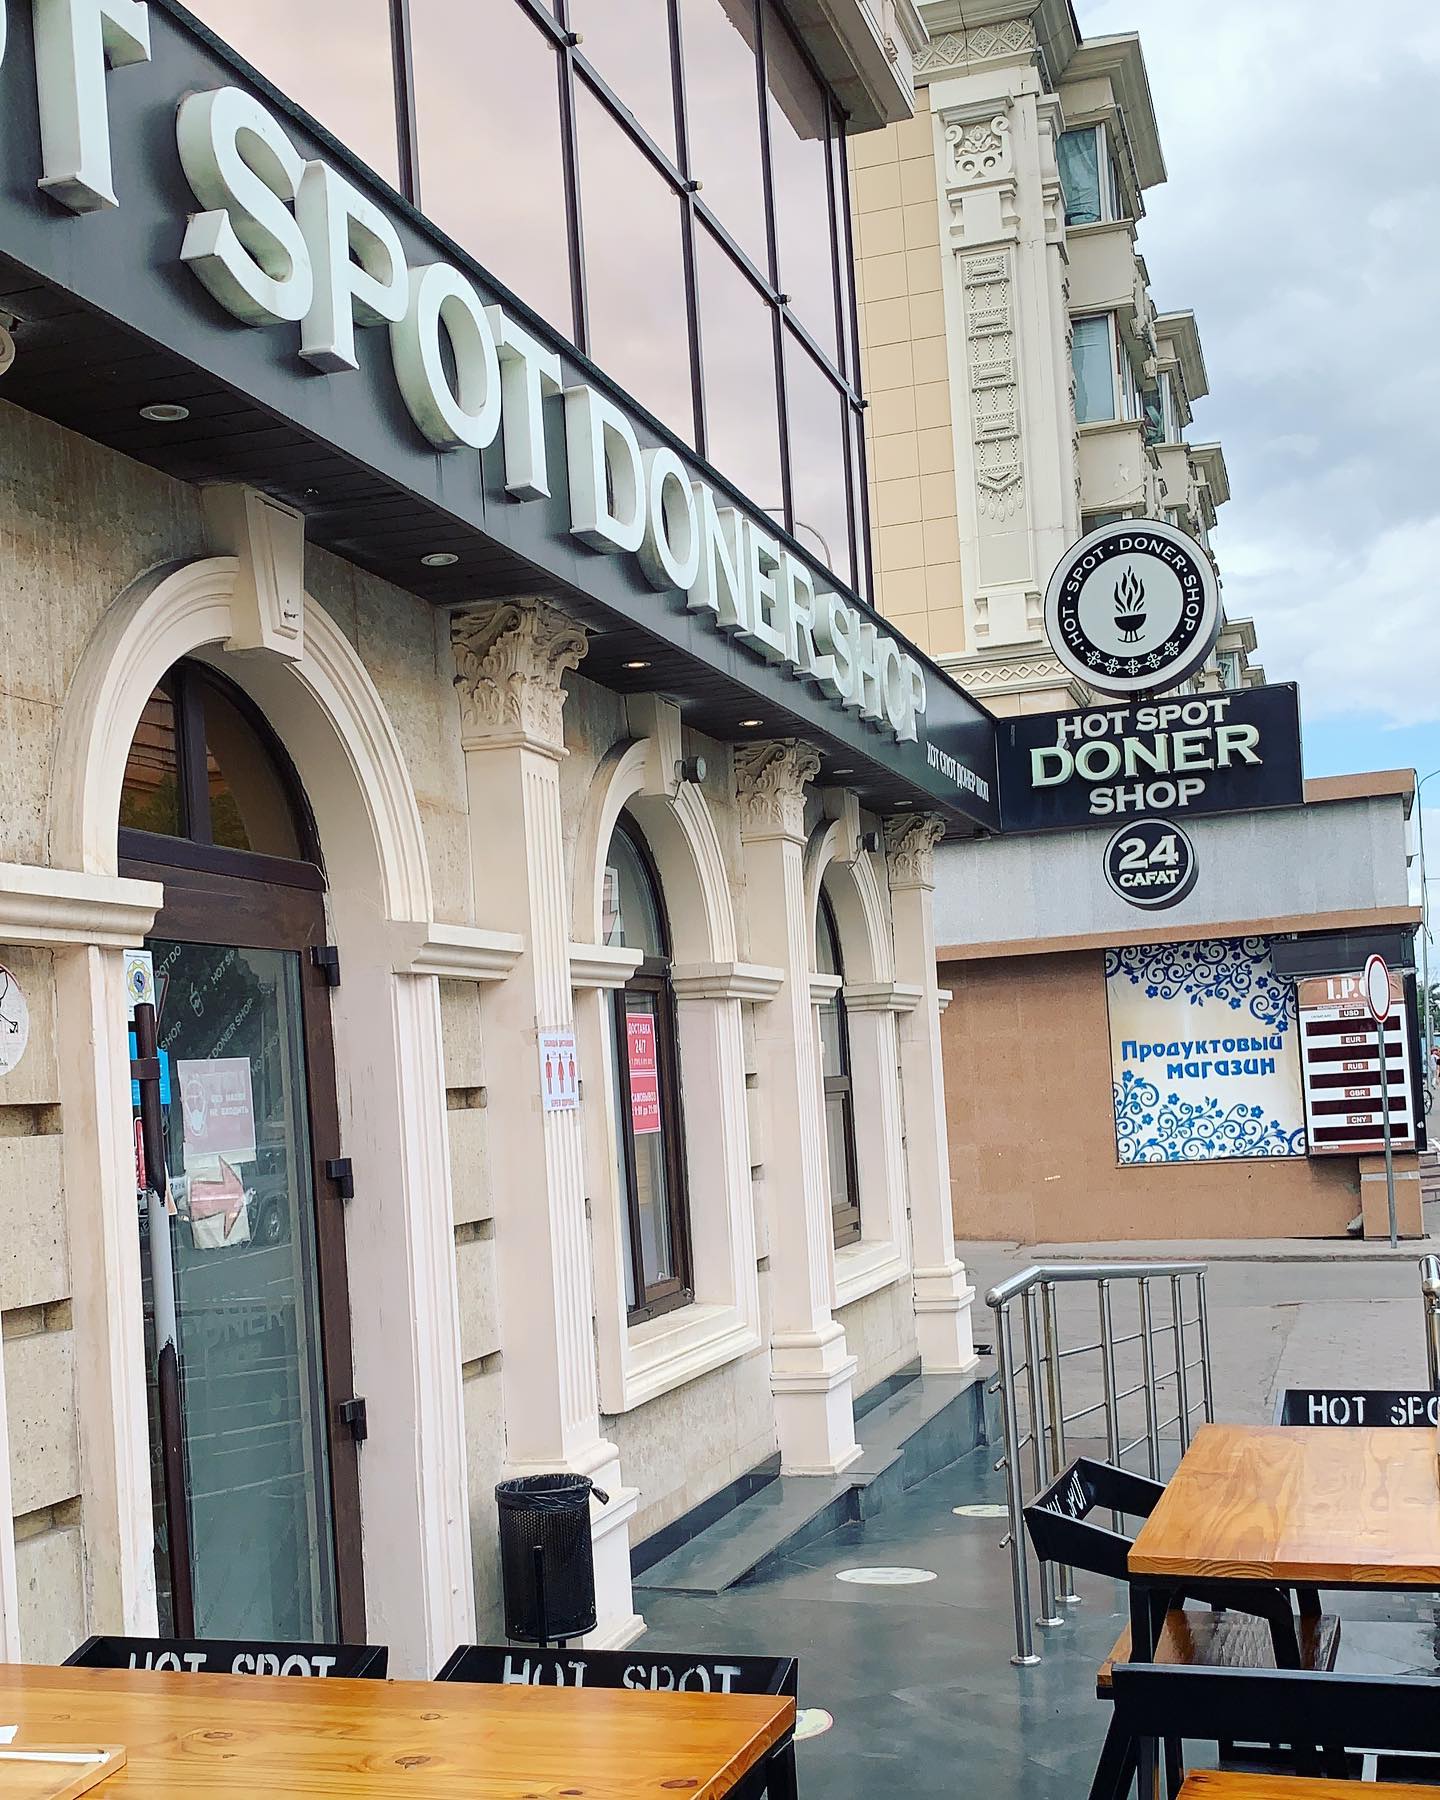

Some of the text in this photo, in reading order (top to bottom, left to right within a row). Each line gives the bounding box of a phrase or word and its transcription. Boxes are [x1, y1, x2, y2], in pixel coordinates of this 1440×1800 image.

[177, 86, 562, 502] SPOT
[564, 384, 818, 681] DONER
[813, 592, 926, 743] SHOP
[1062, 537, 1200, 647] HOT SPOT DONER SHOP
[1057, 697, 1230, 740] HOT SPOT
[939, 750, 956, 781] СПОТ
[956, 762, 976, 793] ДОНЕР
[1030, 724, 1263, 788] DONER
[1089, 777, 1206, 815] SHOP
[1118, 834, 1179, 871] 24
[1343, 1009, 1359, 1017] USD
[1121, 1032, 1283, 1063] Продуктовый
[1345, 1035, 1361, 1043] EUR
[1167, 1058, 1275, 1079] магазин
[1351, 1116, 1367, 1124] CNY
[1308, 1394, 1367, 1425] HOT
